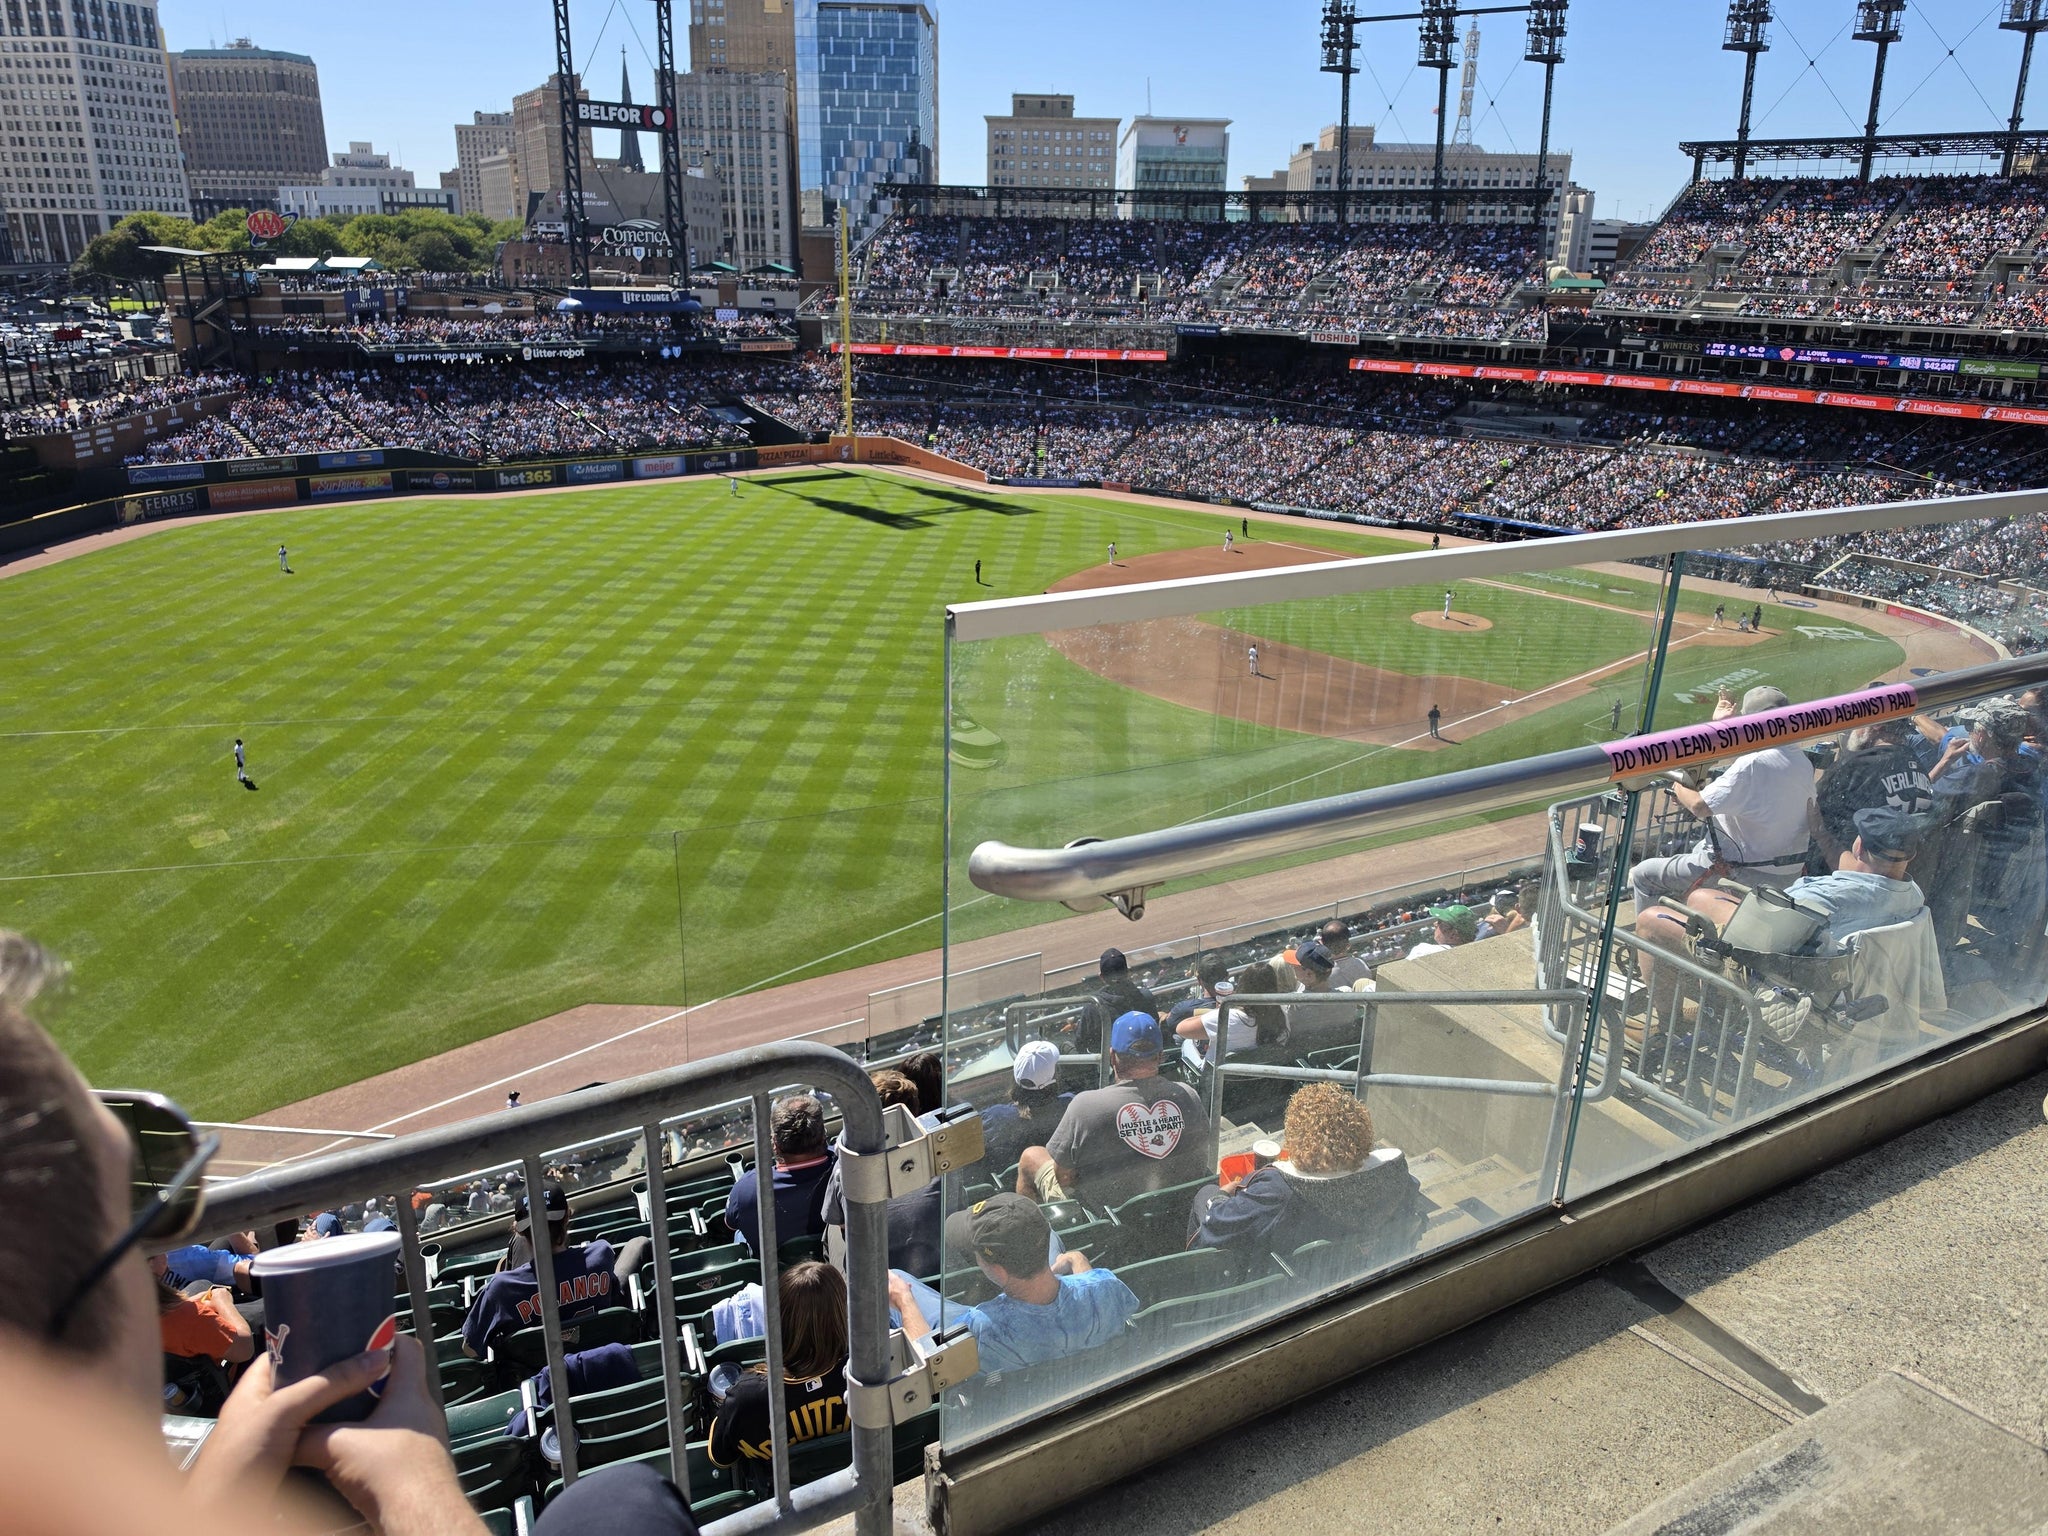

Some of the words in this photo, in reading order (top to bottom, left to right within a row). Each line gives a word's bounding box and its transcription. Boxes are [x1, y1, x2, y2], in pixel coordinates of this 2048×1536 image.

[578, 103, 641, 124] BELFOR
[641, 293, 670, 302] LOUNGE
[1312, 332, 1359, 344] TOSHIBA
[1662, 341, 1700, 352] WINTER'S
[1748, 345, 1766, 353] 0-0
[407, 353, 431, 362] FIFTH
[1755, 389, 1772, 397] Little
[1773, 390, 1798, 399] Caesars
[1831, 396, 1850, 405] Little
[1850, 398, 1877, 407] Caesars
[1913, 402, 1933, 412] Little
[1934, 405, 1962, 414] Caesars
[2001, 411, 2023, 420] Little
[2024, 413, 2048, 423] Caesar
[584, 463, 617, 473] McLaren
[644, 459, 675, 474] meijer
[500, 470, 552, 486] bet365
[145, 492, 194, 511] FERRIS
[1612, 748, 1637, 773] DO
[1641, 740, 1671, 767] NOT
[1672, 734, 1717, 760] LEAN,
[1719, 726, 1741, 752] SIT
[1743, 721, 1766, 744] ON
[1768, 717, 1788, 738] OR
[1791, 706, 1833, 734] STAND
[1835, 695, 1886, 724] AGAINST
[1889, 690, 1916, 716] RAIL
[1121, 1120, 1152, 1130] HUSTLE
[1158, 1115, 1181, 1125] HEART
[1120, 1129, 1137, 1138] SET
[1139, 1126, 1153, 1135] US
[516, 1271, 610, 1325] POANCO
